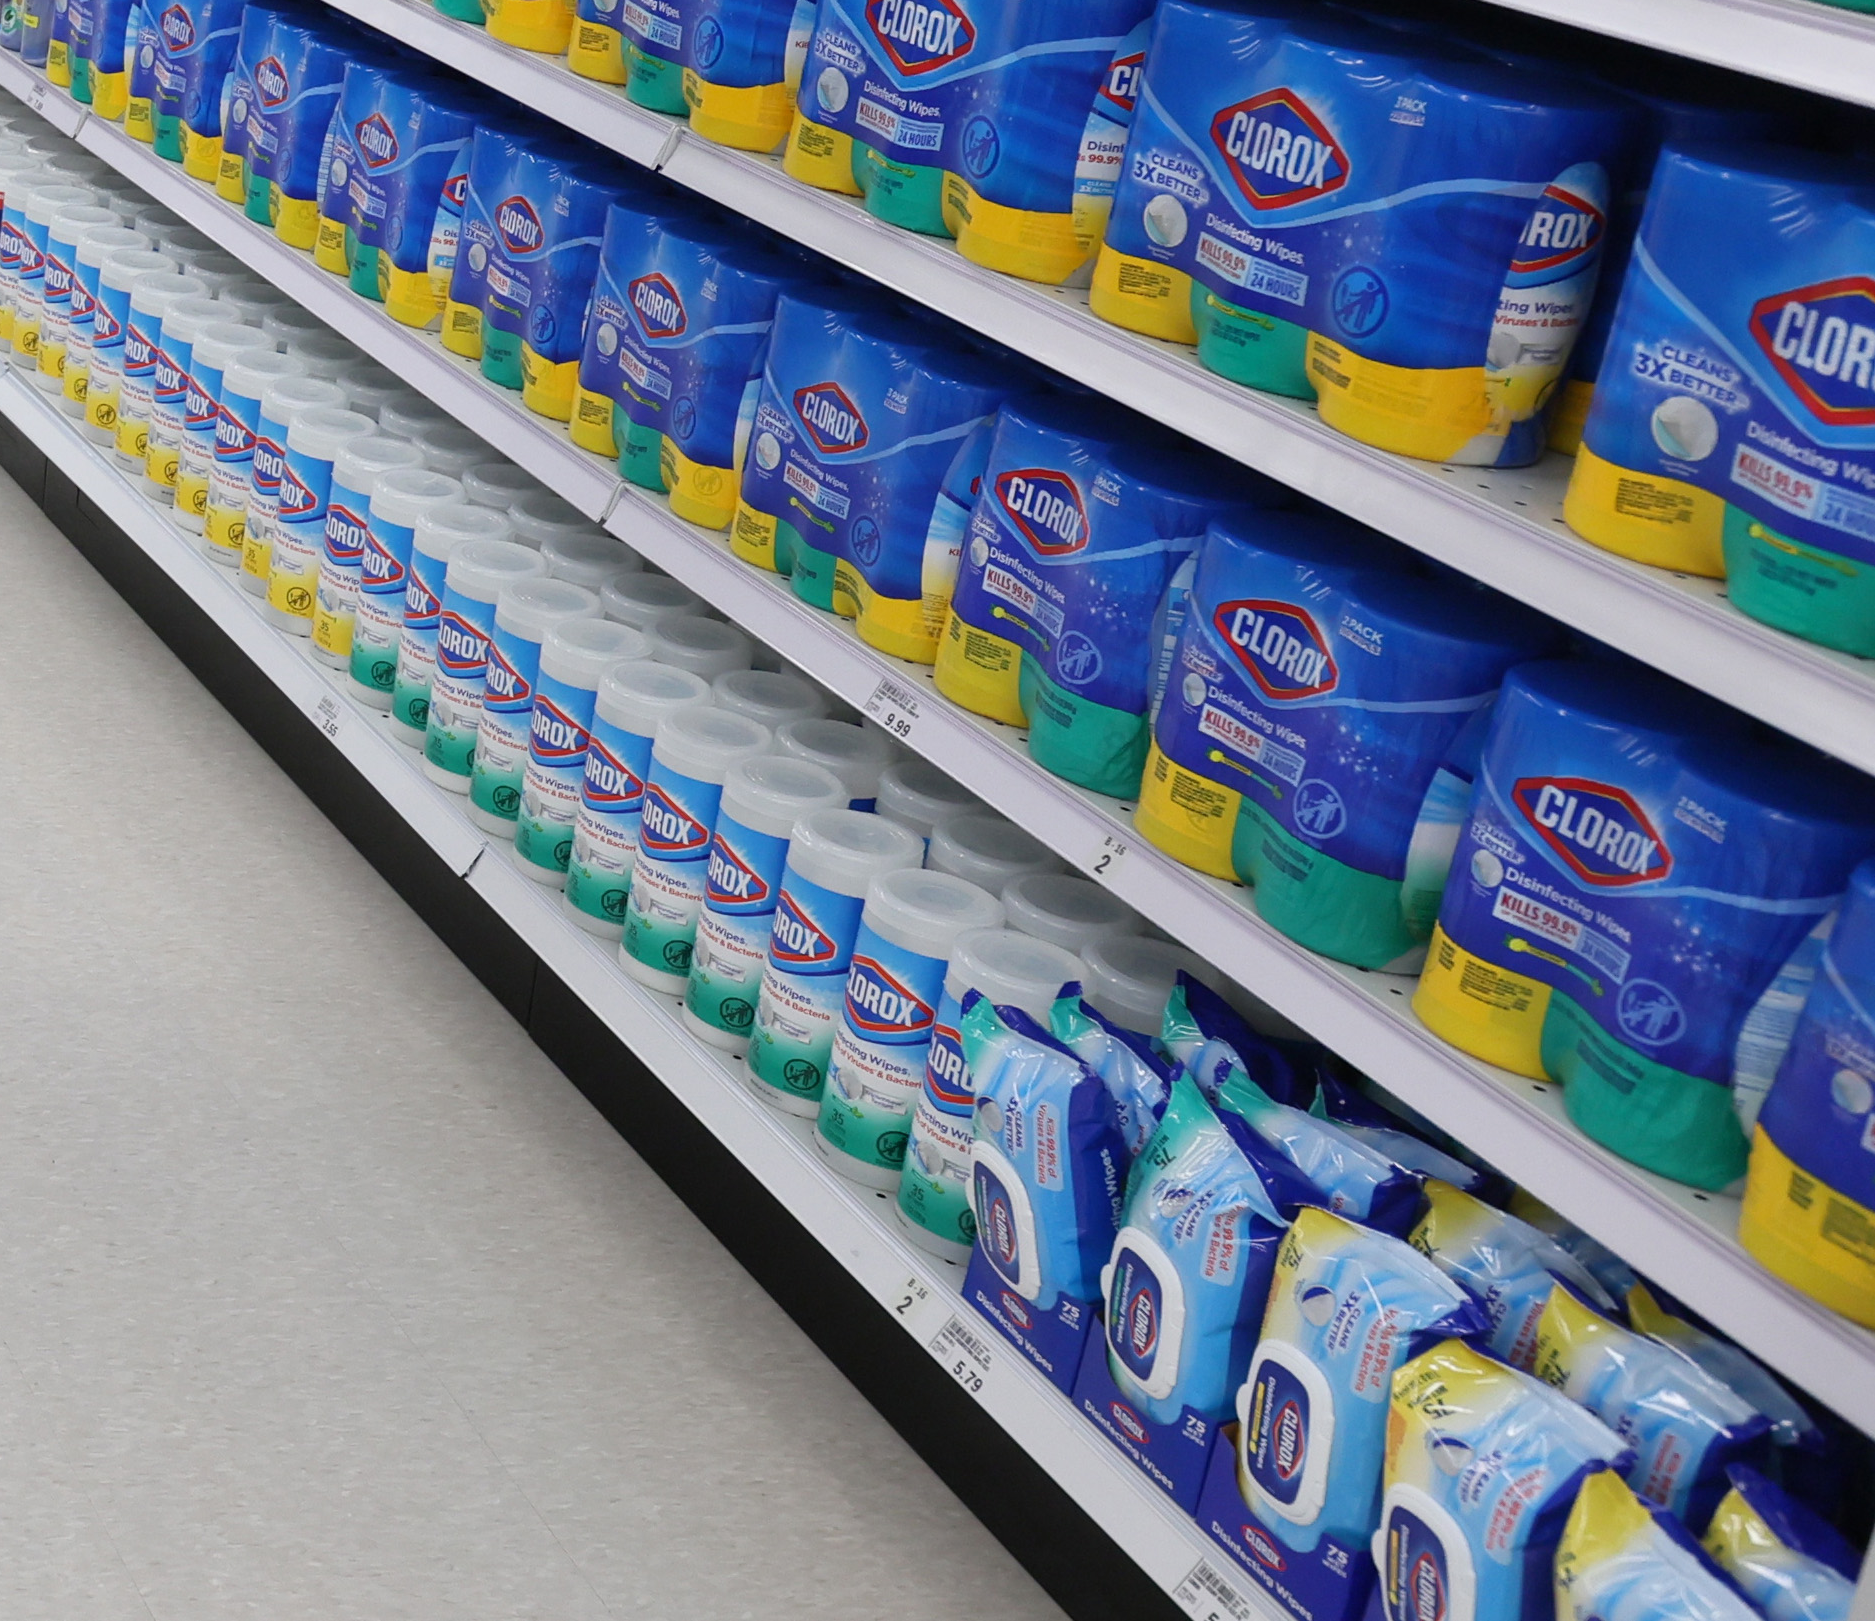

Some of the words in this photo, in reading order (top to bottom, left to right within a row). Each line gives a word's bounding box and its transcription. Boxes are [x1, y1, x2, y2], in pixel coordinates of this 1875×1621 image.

[1151, 153, 1199, 180] CLEANS
[1224, 110, 1336, 188] CLOROX
[1133, 160, 1157, 184] 3X
[1157, 172, 1203, 201] BETTER
[1205, 212, 1262, 250] Disinfecting
[1250, 271, 1264, 289] 24
[1265, 275, 1301, 302] HOURS
[1634, 350, 1670, 383] 3X
[1668, 370, 1738, 407] BETTER
[1661, 345, 1735, 382] CLEANS
[802, 392, 858, 446] CLOROX
[1231, 608, 1328, 689] CLOROX
[883, 711, 911, 737] 9.99
[1535, 784, 1655, 874] CLOROX
[1688, 800, 1727, 830] PACK
[1500, 892, 1543, 931] KILLS
[1540, 910, 1579, 943] 99.9%
[1505, 867, 1594, 924] Disinfecting
[1593, 906, 1631, 943] Wipes
[848, 967, 918, 1027] LOROX
[831, 1109, 844, 1125] 35
[896, 1296, 912, 1315] 2
[1061, 1301, 1080, 1318] 75
[1134, 1293, 1154, 1354] CLOROX
[976, 1290, 1024, 1347] Disinfecting
[1024, 1339, 1053, 1372] Wipes
[953, 1360, 983, 1393] 5.79
[1278, 1409, 1298, 1472] CLOROX
